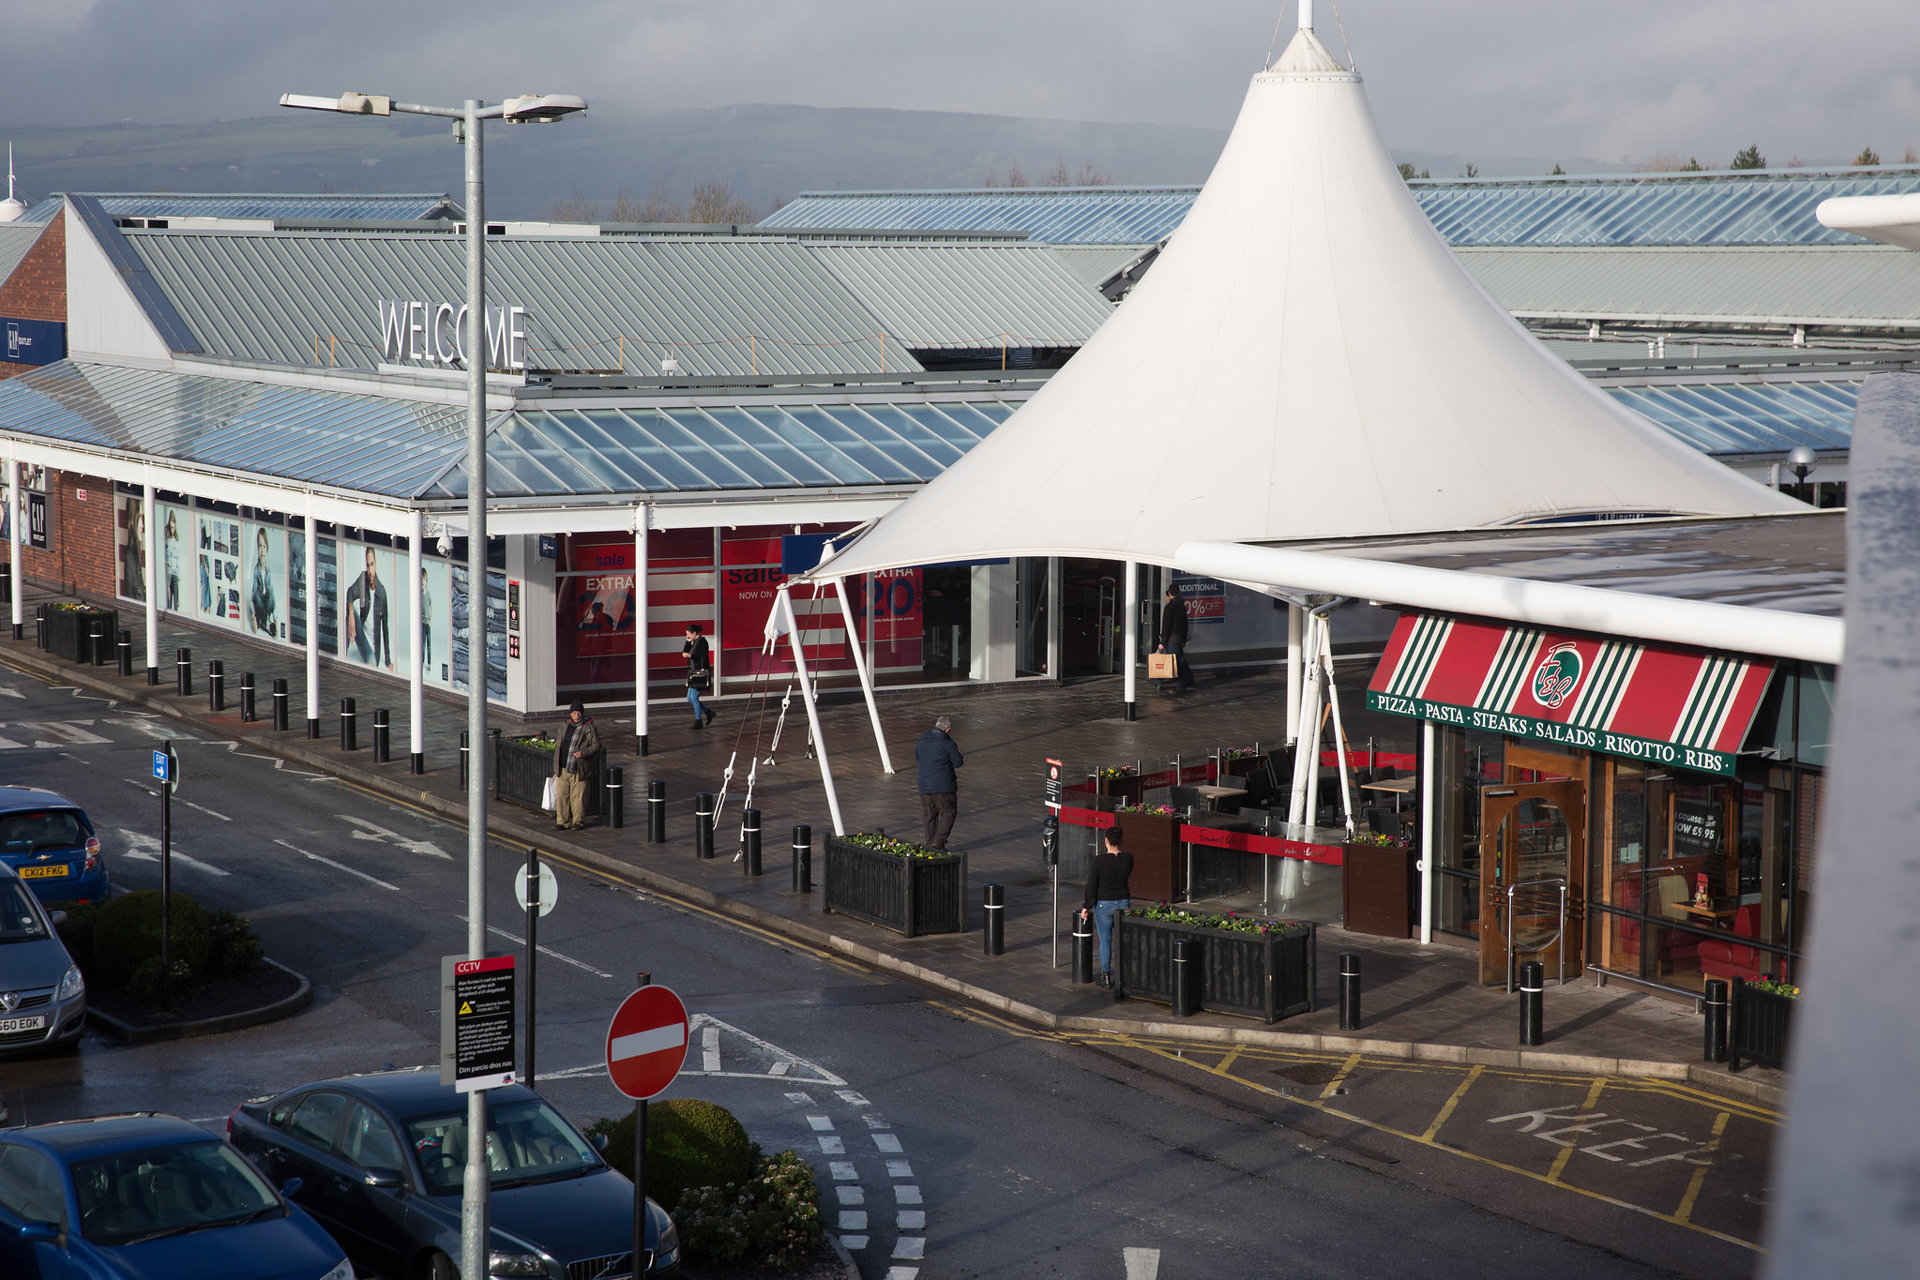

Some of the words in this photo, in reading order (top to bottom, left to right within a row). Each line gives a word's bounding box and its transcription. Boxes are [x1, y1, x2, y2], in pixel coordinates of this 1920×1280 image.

[31, 501, 45, 533] GAP
[595, 552, 625, 568] sale
[728, 559, 783, 585] sale
[586, 575, 635, 591] EXTRA
[739, 591, 759, 600] NOW
[760, 590, 773, 599] ON
[1377, 695, 1417, 716] PIZZA
[1425, 703, 1465, 724] PASTA
[1473, 711, 1527, 735] STEAKS
[1535, 722, 1596, 748] SALADS
[1604, 734, 1675, 762] RISOTTO
[1684, 749, 1723, 772] RIBS
[1692, 826, 1716, 840] £9.95
[24, 867, 45, 877] CK12
[46, 866, 64, 876] FKG
[457, 961, 481, 973] CCTV
[459, 1066, 471, 1074] Dim
[471, 1064, 489, 1073] parcio
[489, 1061, 501, 1069] dros
